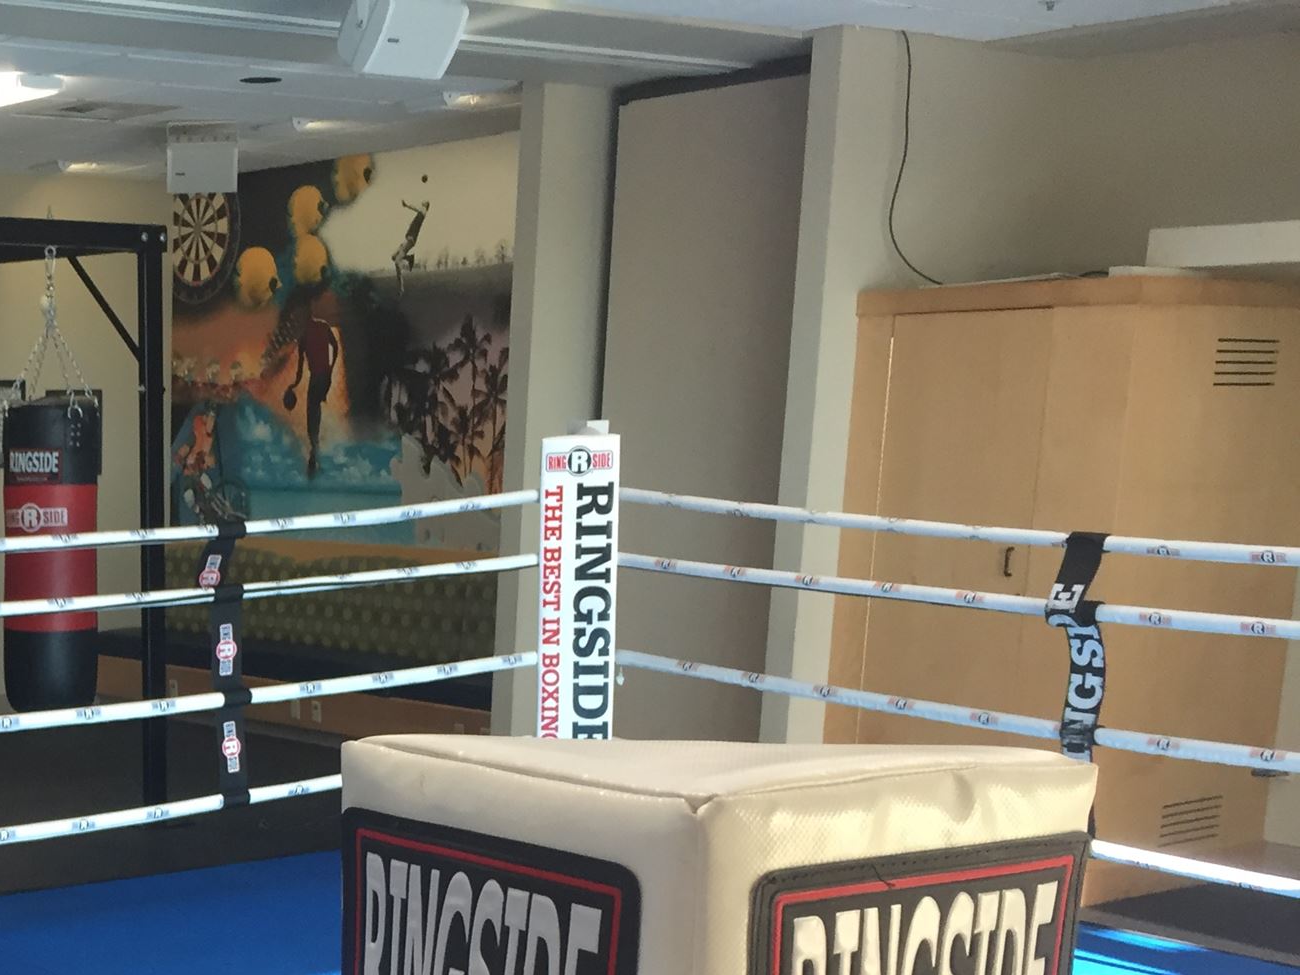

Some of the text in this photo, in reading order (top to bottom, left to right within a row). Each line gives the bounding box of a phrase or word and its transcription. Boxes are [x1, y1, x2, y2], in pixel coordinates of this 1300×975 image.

[10, 451, 59, 473] RINGSIDE
[548, 455, 567, 471] RING
[592, 451, 612, 468] SIDE
[43, 510, 66, 525] SIDE
[540, 485, 564, 739] THE BEST IN BOXIN
